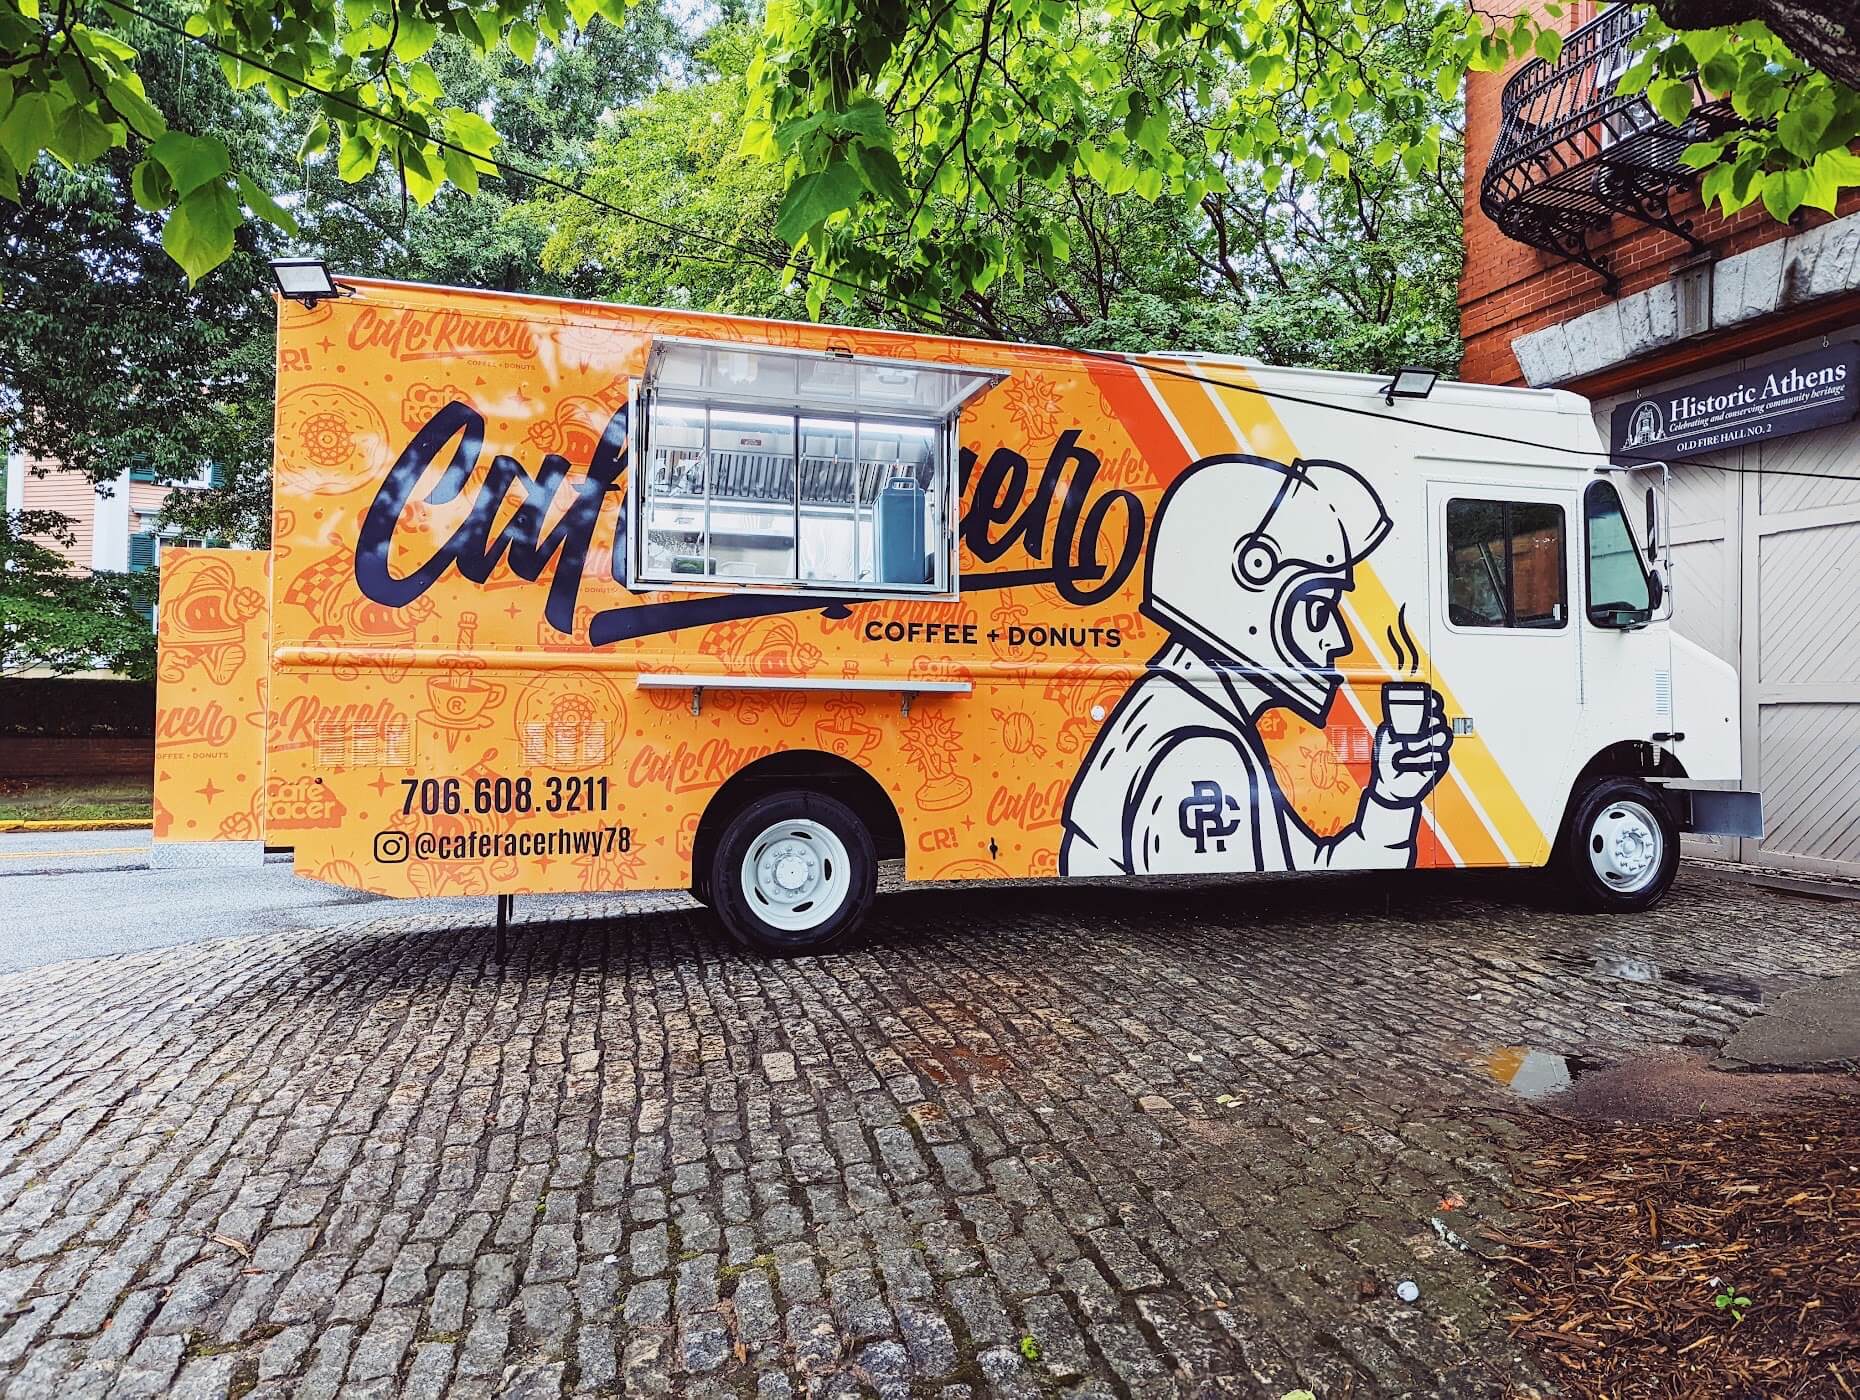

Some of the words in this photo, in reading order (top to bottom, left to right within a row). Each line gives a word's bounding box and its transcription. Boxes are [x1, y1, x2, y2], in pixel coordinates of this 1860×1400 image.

[278, 348, 313, 373] R!
[1669, 384, 1756, 422] Historic
[1760, 364, 1847, 400] Athens
[1669, 417, 1710, 433] Celebrating
[1710, 411, 1726, 423] and
[1725, 402, 1766, 419] conserving
[1766, 392, 1811, 409] community
[1811, 384, 1846, 398] heritage
[1677, 440, 1697, 452] OLD
[1698, 435, 1720, 447] FIRE
[1720, 429, 1747, 443] HALL
[1747, 425, 1765, 437] NO.
[1766, 423, 1772, 433] 2
[865, 621, 978, 645] COFFEE
[986, 629, 1000, 643] +
[1008, 626, 1121, 648] DONUTS
[193, 751, 229, 759] DONUTS
[627, 741, 700, 792] Cafe
[266, 801, 337, 821] acer
[401, 776, 609, 816] 706.608.3211
[986, 782, 1047, 829] Cafe
[415, 827, 631, 860] @caferacerhwy78
[918, 827, 959, 853] CR!
